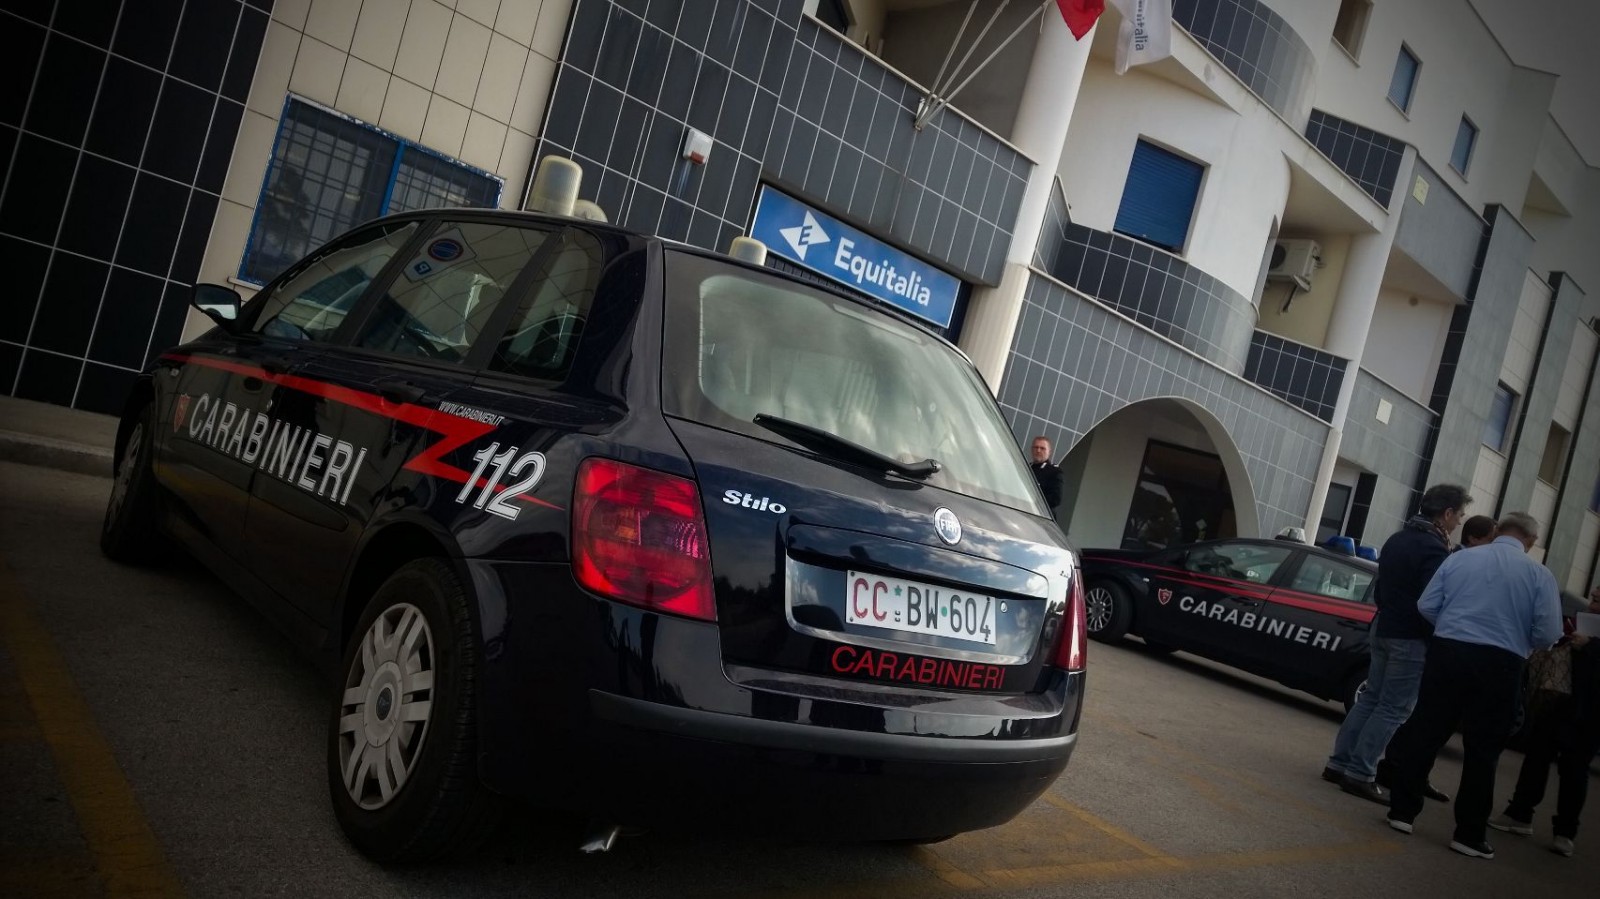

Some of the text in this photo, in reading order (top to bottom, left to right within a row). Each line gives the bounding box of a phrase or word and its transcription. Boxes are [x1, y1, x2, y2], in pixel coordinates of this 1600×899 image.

[834, 237, 931, 307] Equitalia
[189, 393, 368, 506] CARABINIERI
[455, 441, 547, 521] 112
[722, 489, 787, 514] Stilo
[853, 577, 991, 639] CC BW 604
[1179, 596, 1342, 652] CARABINIERI
[831, 645, 1006, 689] CARABINIERI
